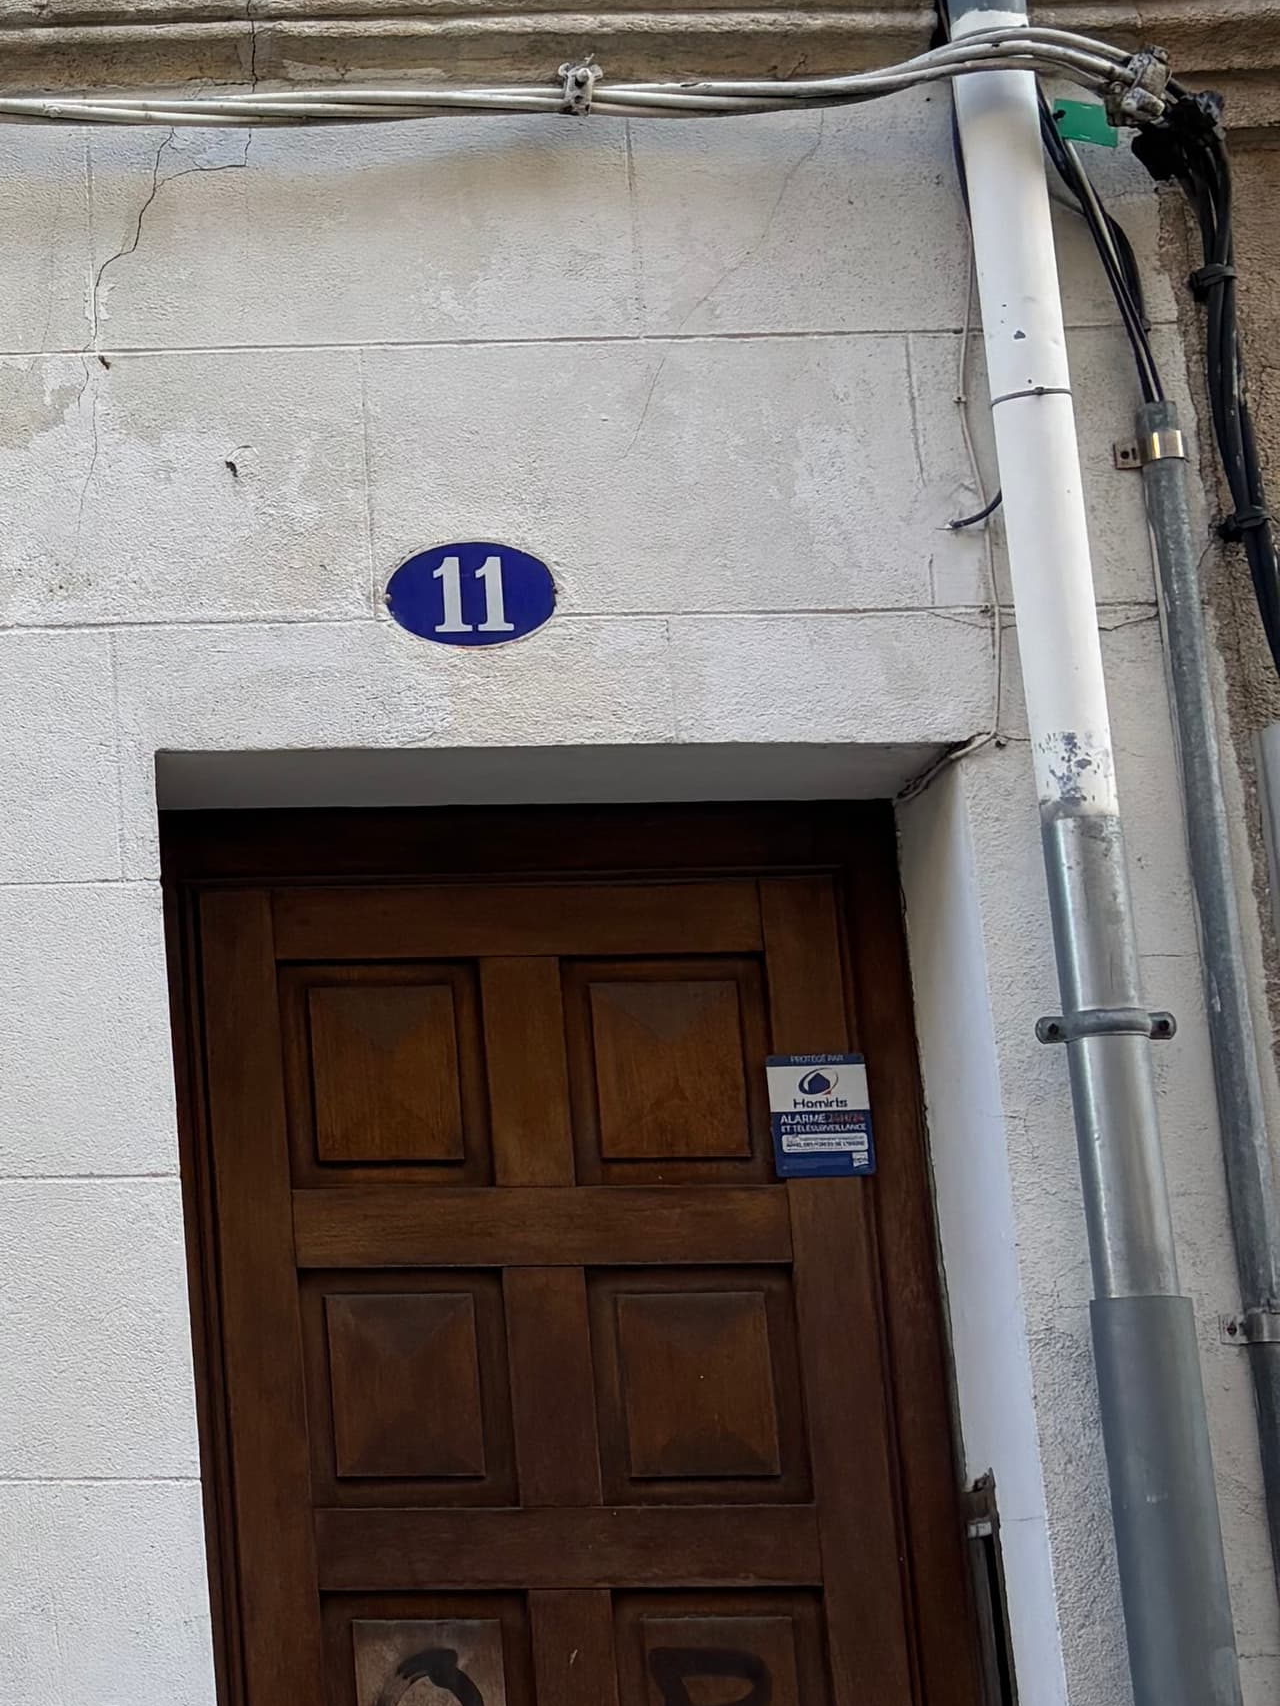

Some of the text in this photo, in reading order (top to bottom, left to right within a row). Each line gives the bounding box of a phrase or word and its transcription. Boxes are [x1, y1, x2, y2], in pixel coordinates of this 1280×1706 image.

[432, 556, 515, 633] 11
[793, 1097, 848, 1110] Homiris
[780, 1113, 826, 1125] ALARME
